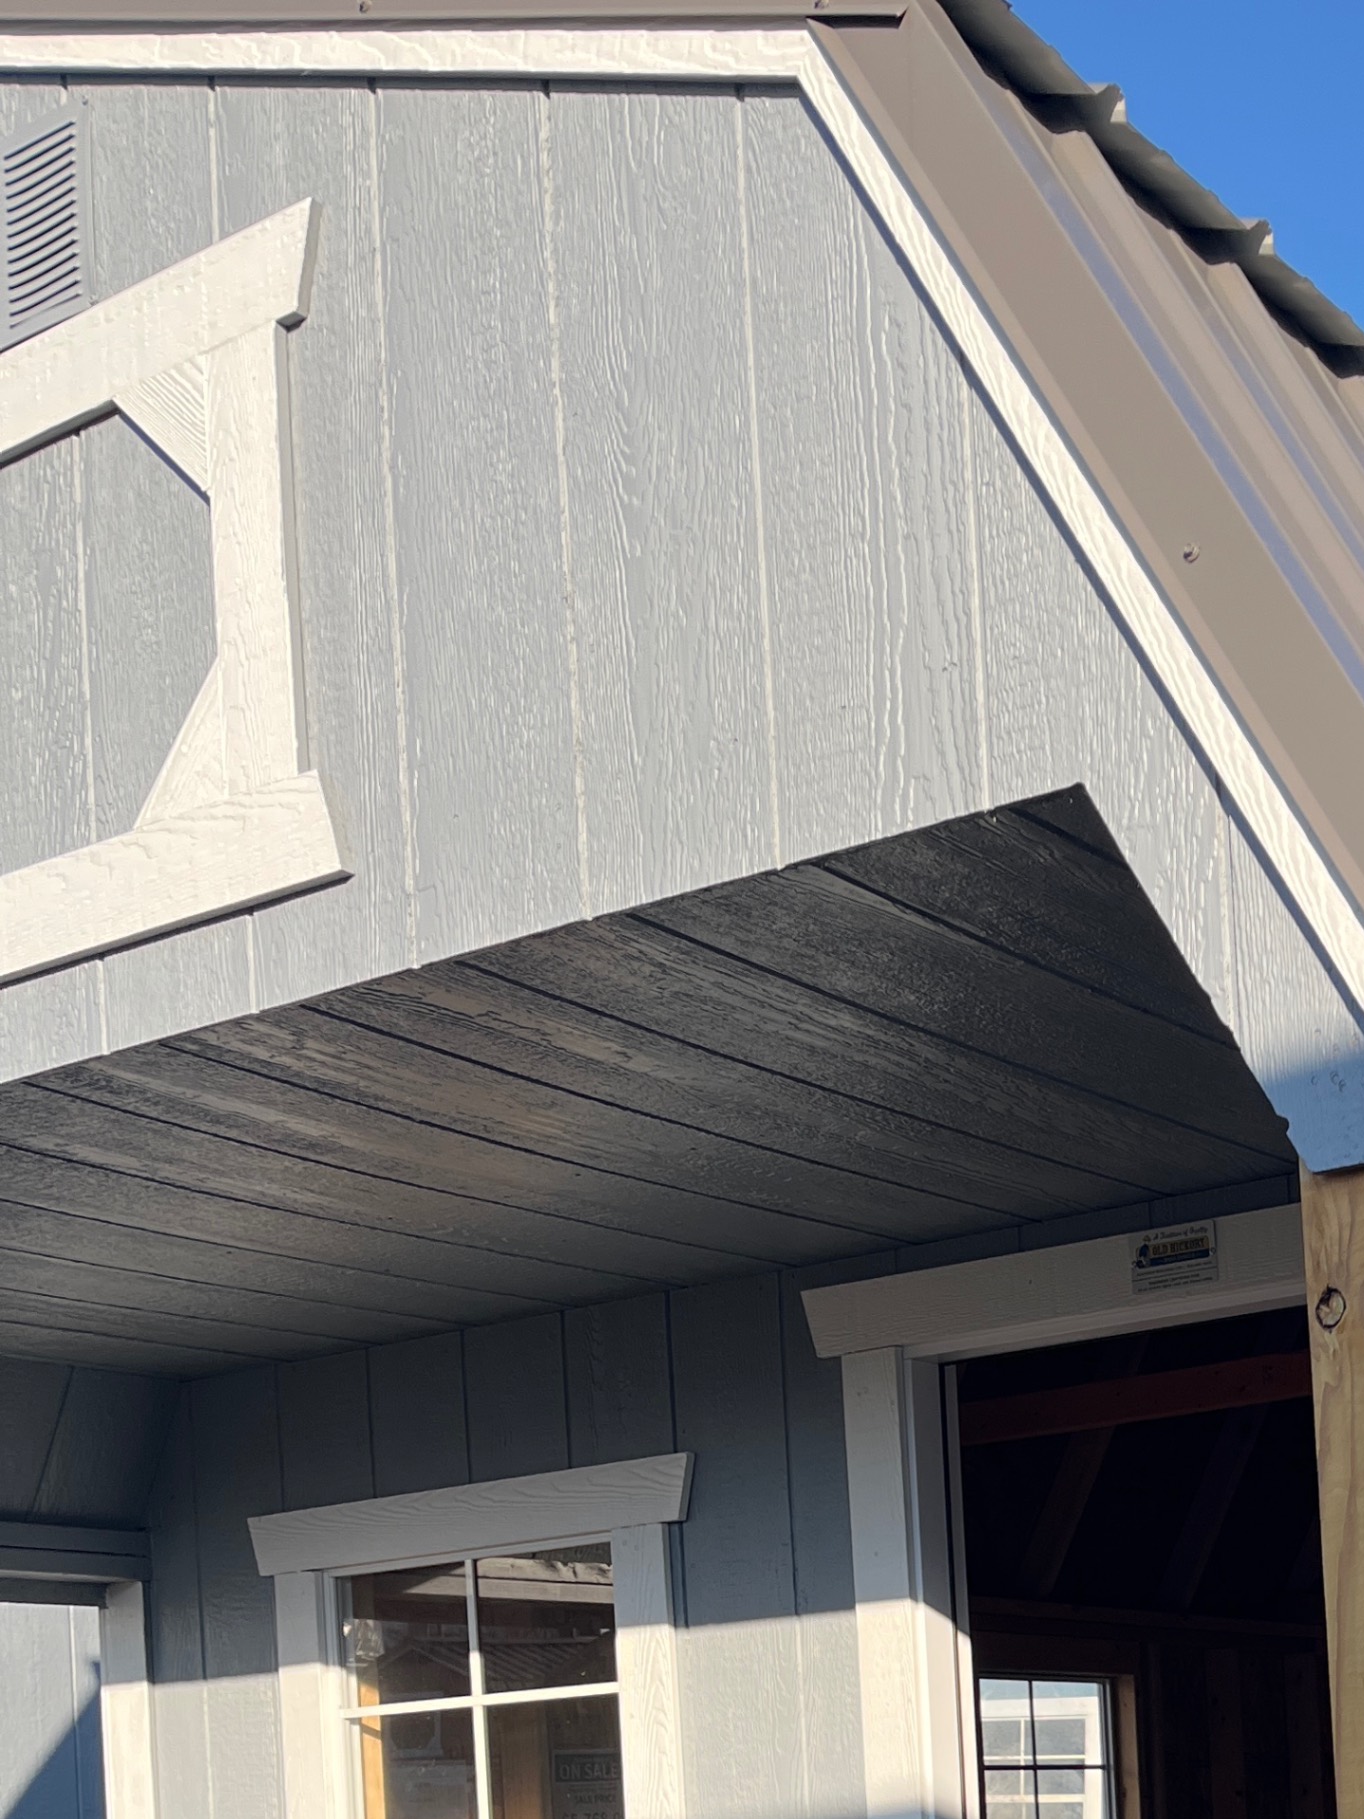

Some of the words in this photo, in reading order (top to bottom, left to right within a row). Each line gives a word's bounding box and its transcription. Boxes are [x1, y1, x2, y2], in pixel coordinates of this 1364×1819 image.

[1153, 1244, 1168, 1256] OLD
[1170, 1238, 1205, 1253] HICKORY
[560, 1763, 581, 1779] ON
[584, 1761, 618, 1778] SALE
